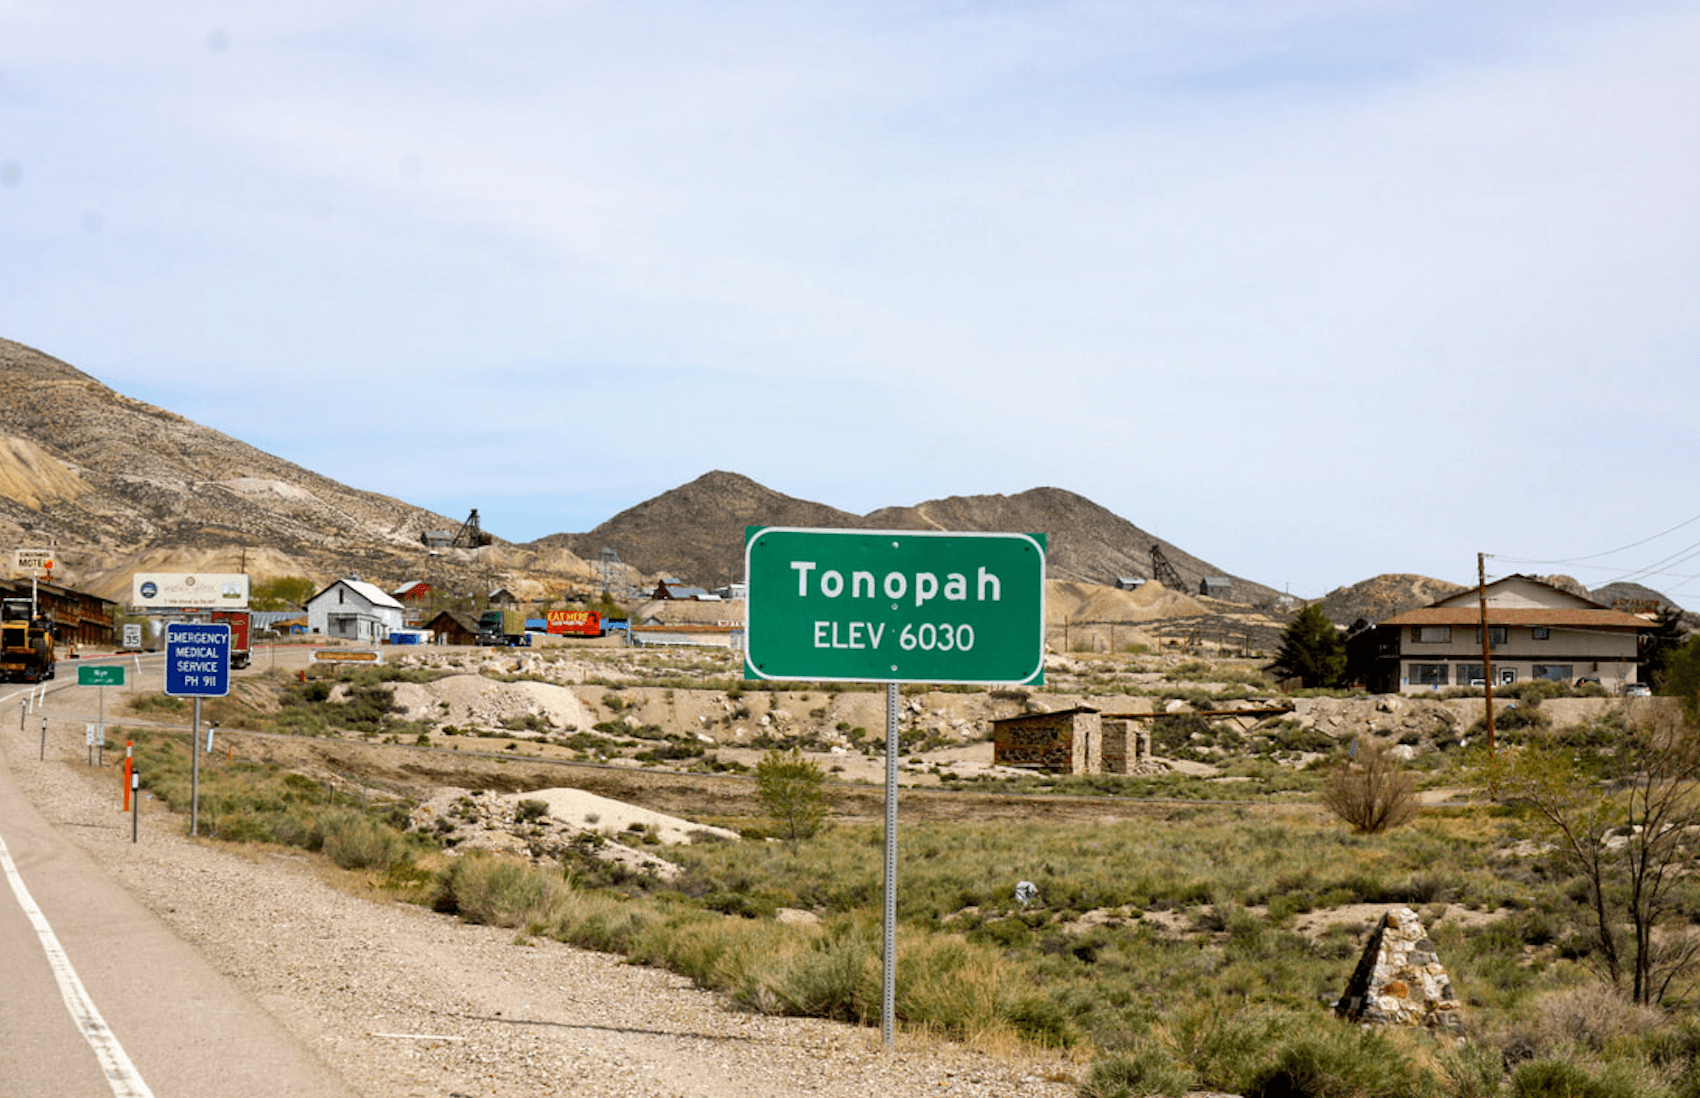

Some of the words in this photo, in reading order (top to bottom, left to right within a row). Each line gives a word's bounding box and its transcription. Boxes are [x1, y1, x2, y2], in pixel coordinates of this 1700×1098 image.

[790, 561, 1001, 607] Tonopah
[126, 635, 139, 645] 35
[167, 632, 228, 644] EMERGENCY
[814, 621, 885, 649] ELEV
[899, 623, 975, 651] 6030
[175, 646, 219, 658] MEDICAL
[177, 660, 218, 672] SERVICE
[184, 675, 199, 686] PH
[203, 675, 216, 686] 911
